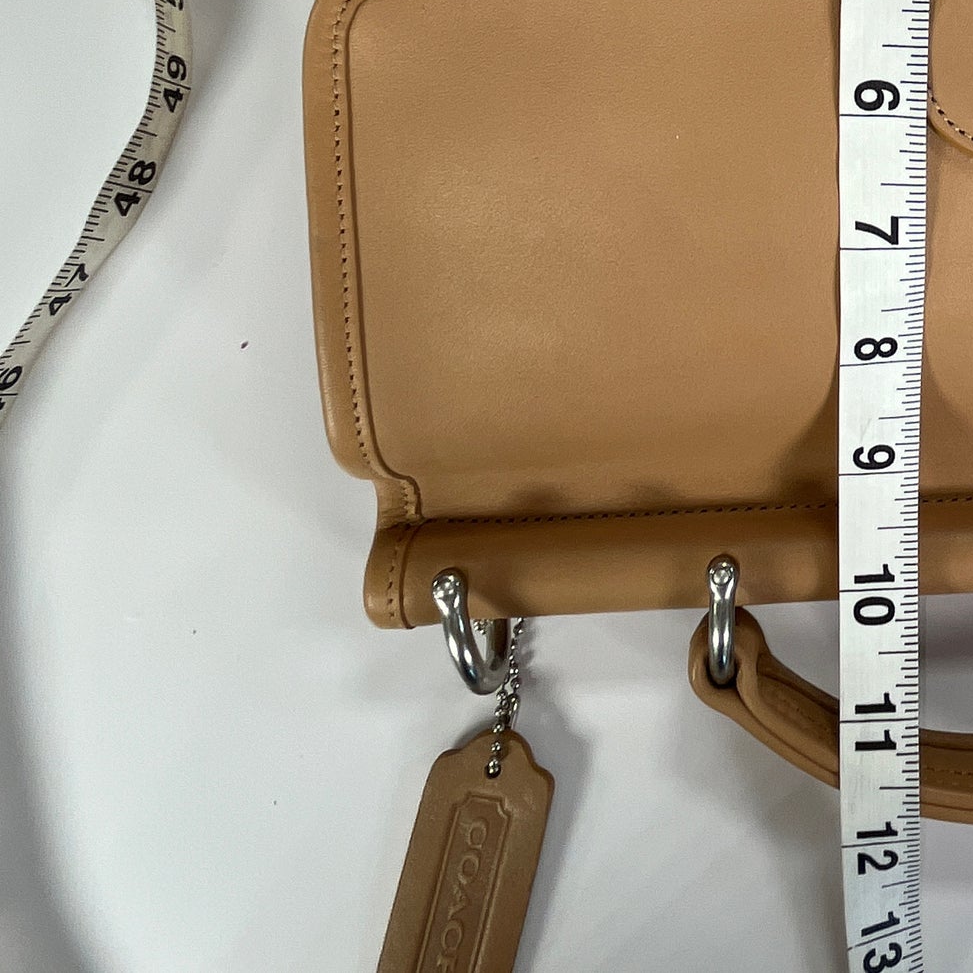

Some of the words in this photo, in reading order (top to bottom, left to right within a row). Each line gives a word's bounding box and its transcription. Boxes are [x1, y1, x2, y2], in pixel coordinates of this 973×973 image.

[163, 55, 187, 113] 49
[854, 79, 901, 111] 6
[114, 160, 156, 217] 48
[855, 216, 899, 245] 7
[49, 263, 89, 316] 47
[854, 337, 898, 361] 8
[853, 444, 896, 470] 9
[853, 564, 896, 626] 10
[855, 692, 897, 751] 11
[856, 822, 898, 875] 12
[861, 911, 903, 973] 13
